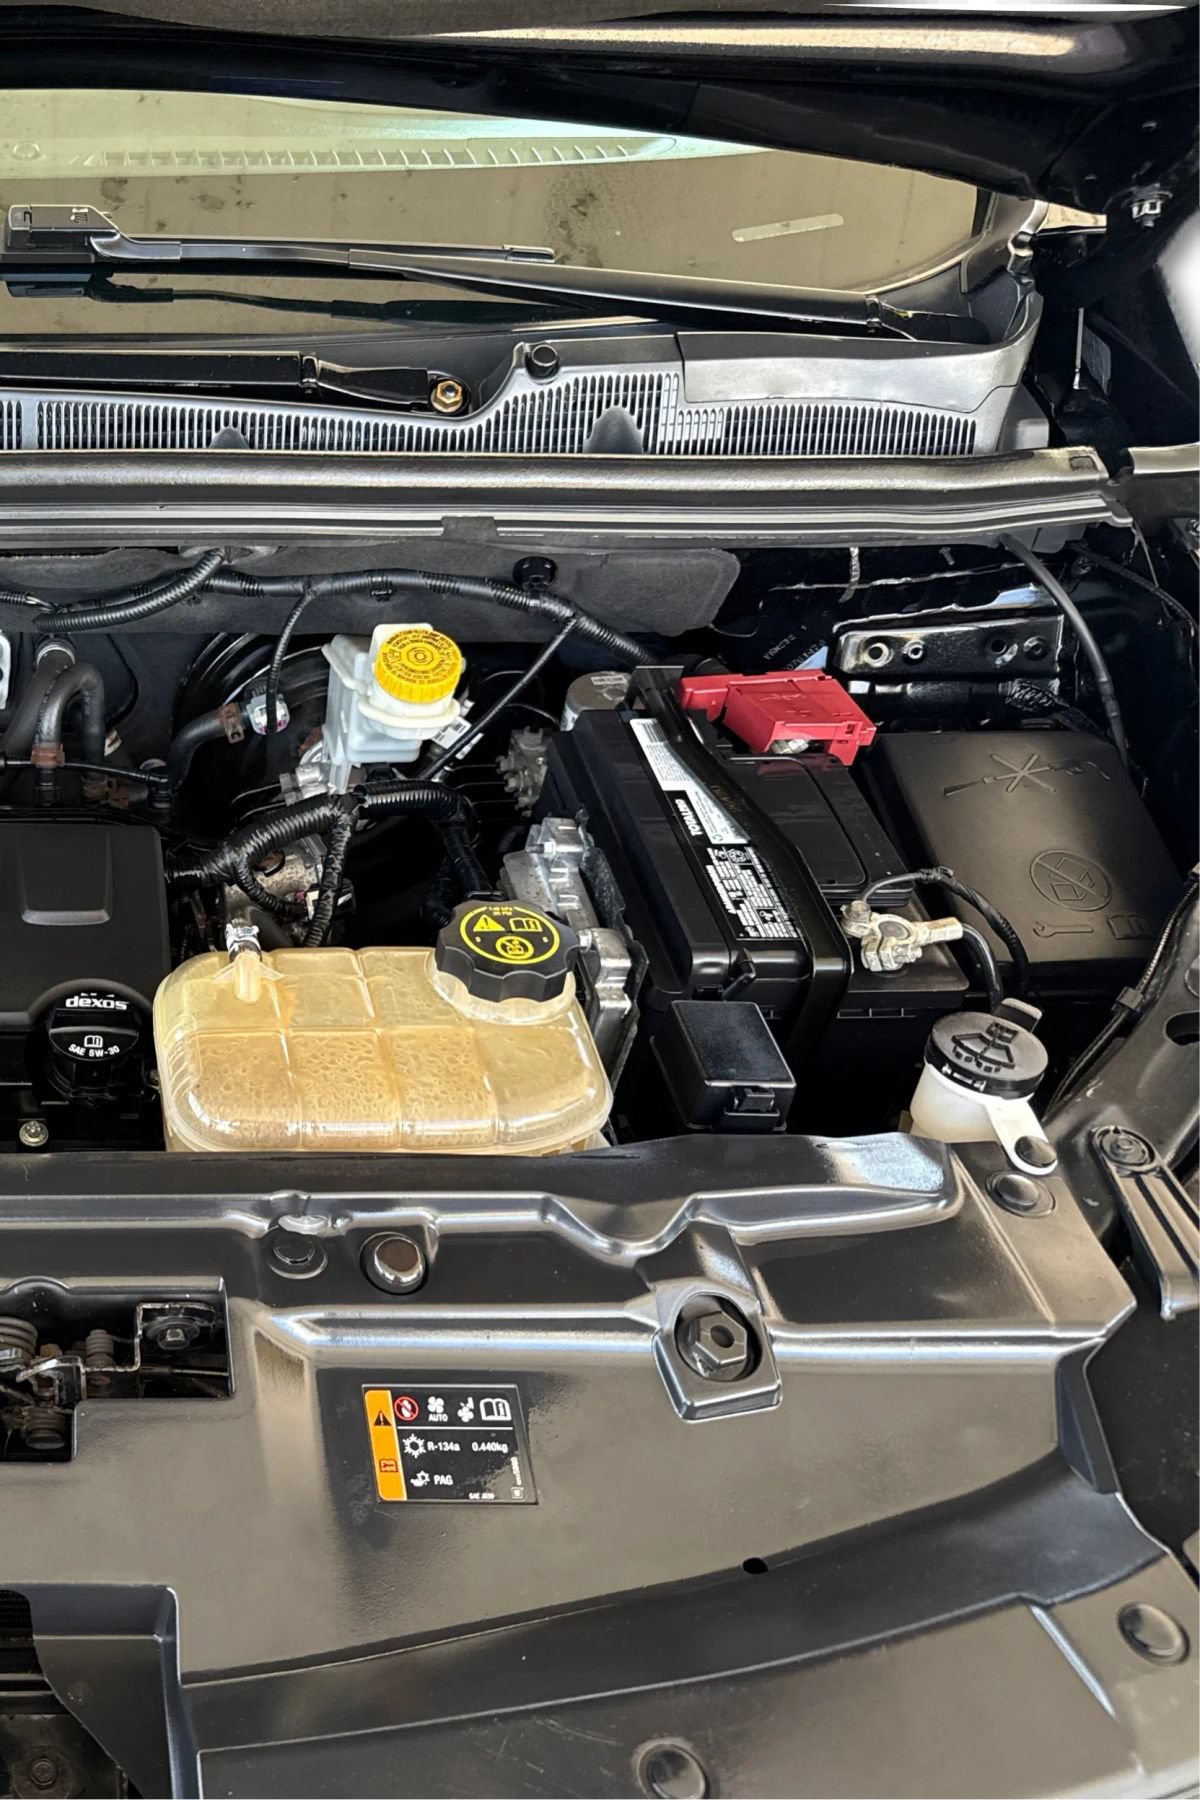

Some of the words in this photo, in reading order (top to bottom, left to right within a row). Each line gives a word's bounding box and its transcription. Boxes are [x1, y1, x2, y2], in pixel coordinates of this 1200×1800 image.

[65, 995, 130, 1011] dexos
[68, 1043, 87, 1056] SAE
[88, 1044, 121, 1058] 5W-30
[428, 1413, 448, 1422] AUTO
[427, 1441, 461, 1452] R-134a
[471, 1441, 509, 1454] 0.440kg
[433, 1474, 454, 1486] PAG
